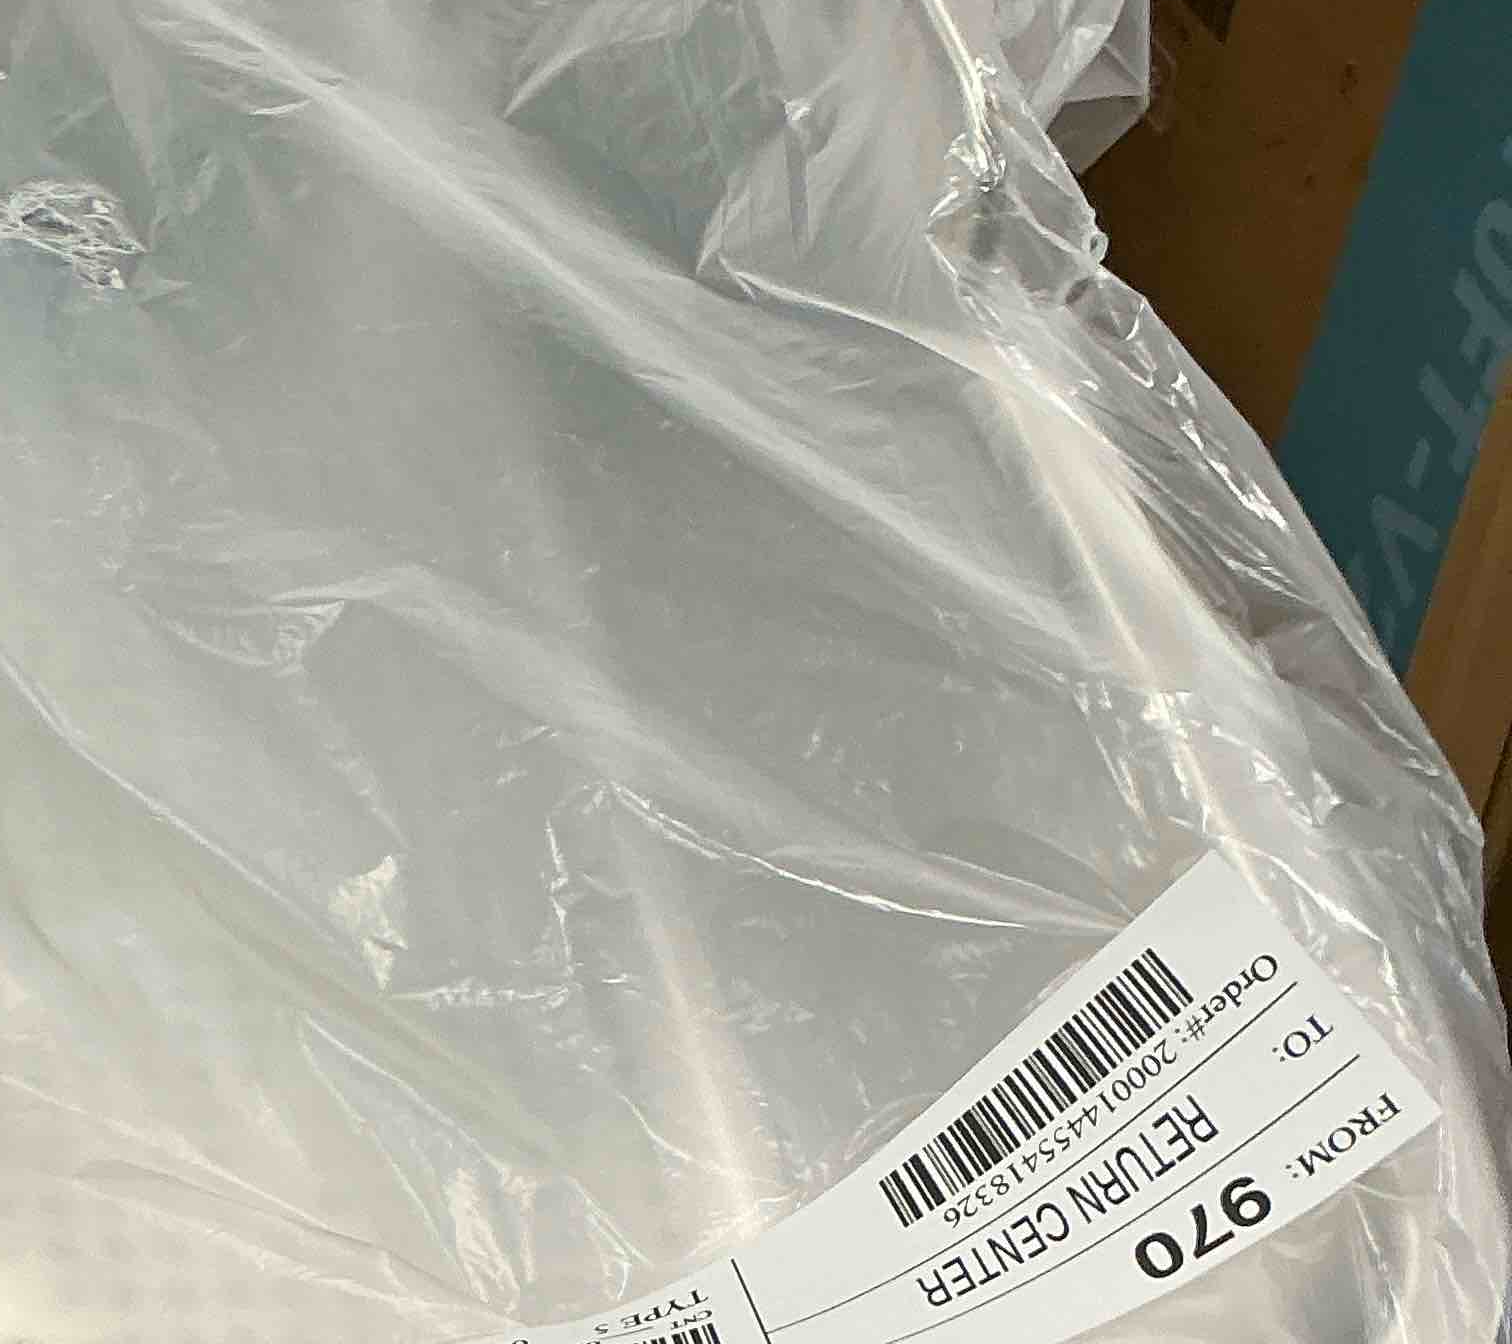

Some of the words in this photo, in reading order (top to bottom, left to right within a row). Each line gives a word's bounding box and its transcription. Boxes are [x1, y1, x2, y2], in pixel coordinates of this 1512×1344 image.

[1174, 954, 1279, 1044] Order#:
[1271, 1014, 1334, 1063] TO:
[943, 1038, 1179, 1230] 200014455418326
[1065, 1094, 1219, 1223] RETURN
[1285, 1092, 1402, 1178] FROM:
[916, 1202, 1071, 1308] CENTER
[1134, 1176, 1272, 1279] 970
[594, 1322, 610, 1335] 5
[620, 1287, 709, 1328] TYPE
[671, 1309, 713, 1332] CNT
